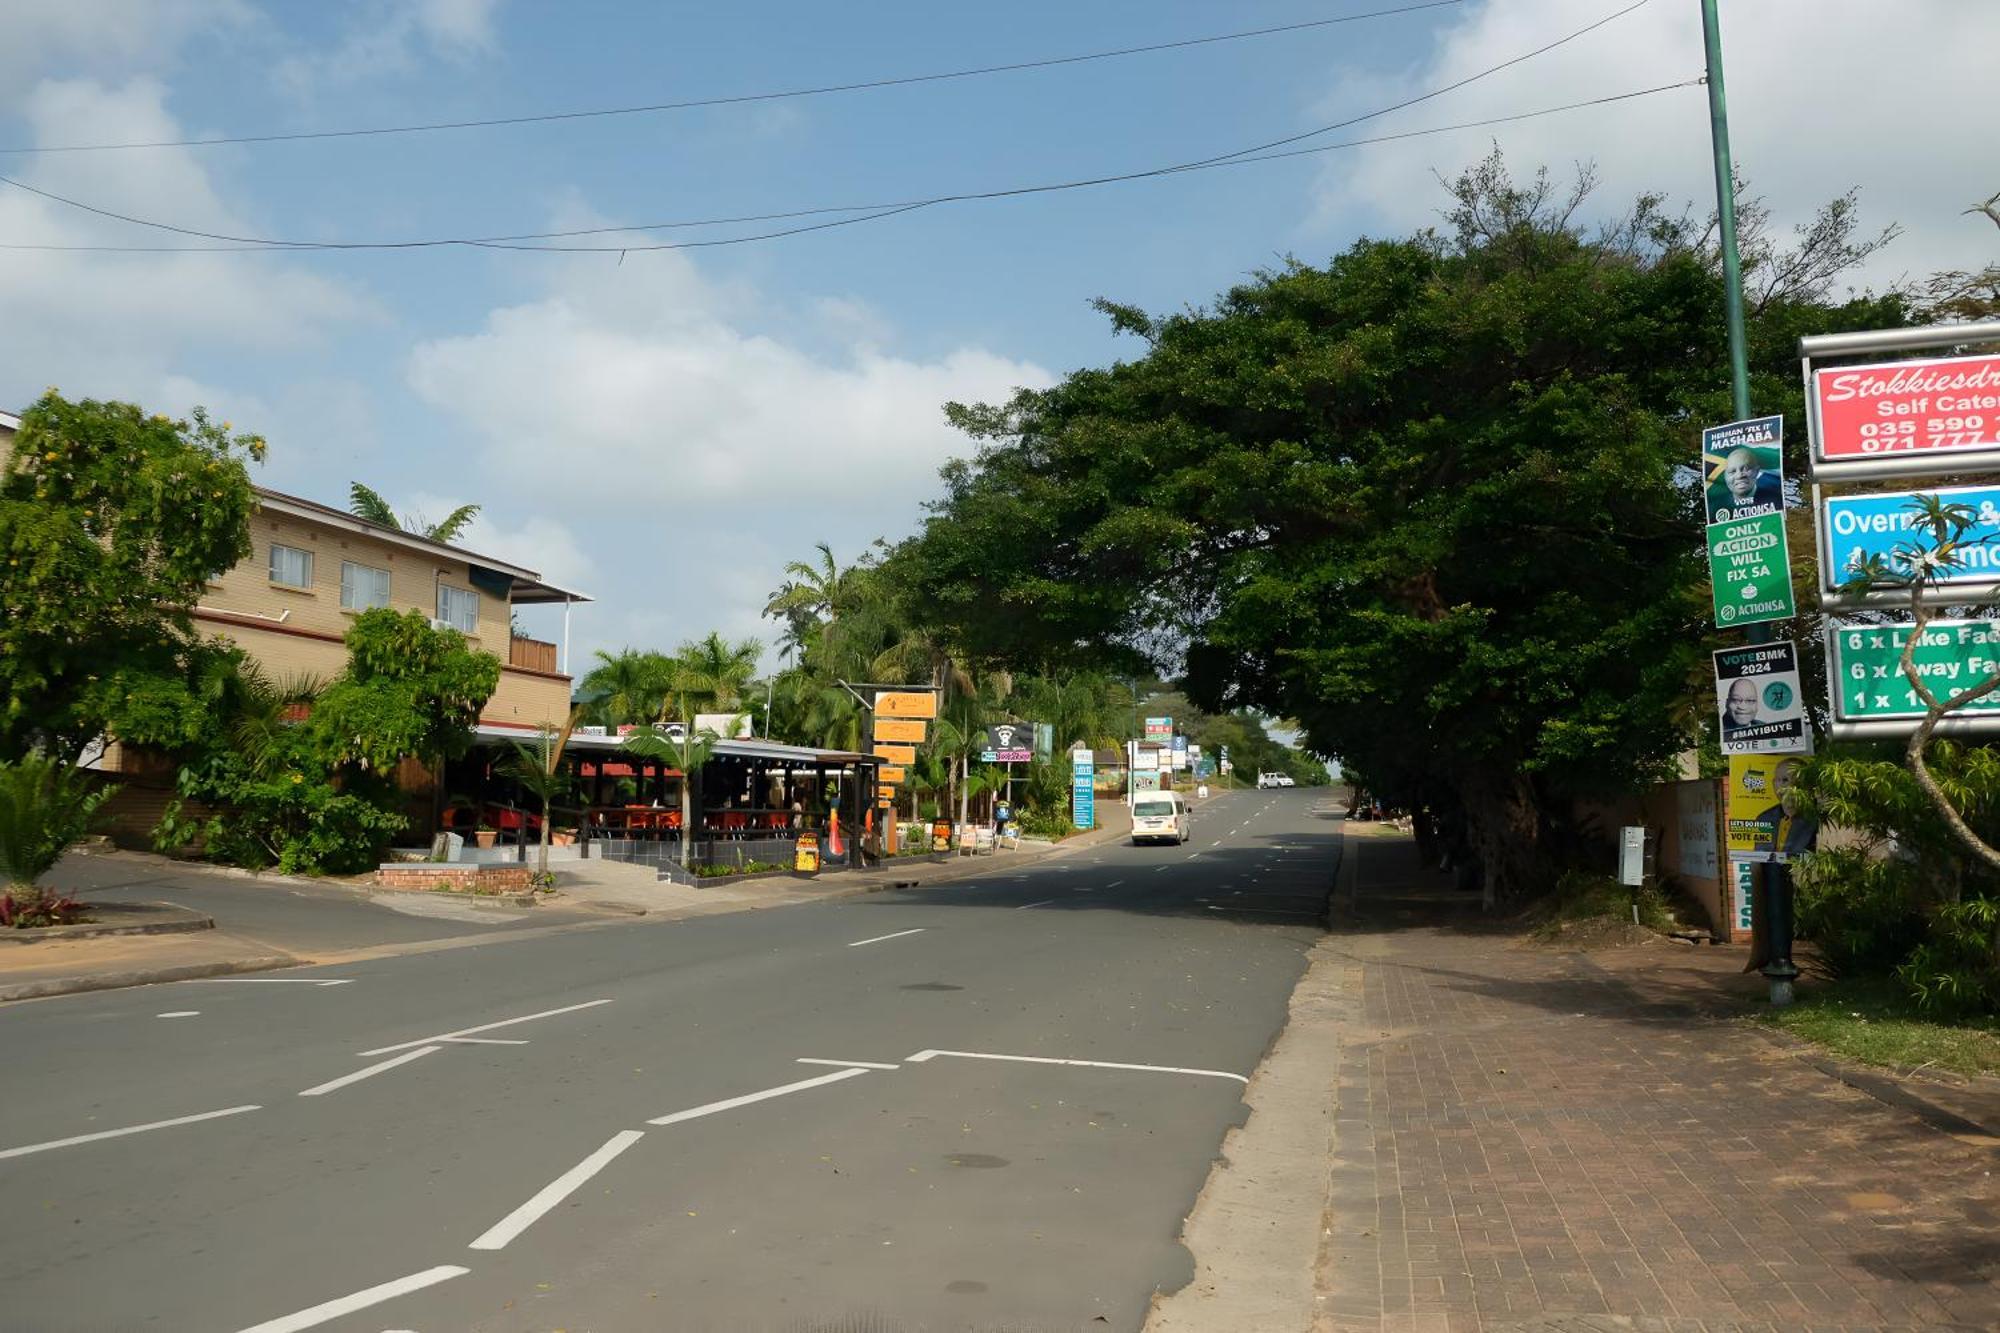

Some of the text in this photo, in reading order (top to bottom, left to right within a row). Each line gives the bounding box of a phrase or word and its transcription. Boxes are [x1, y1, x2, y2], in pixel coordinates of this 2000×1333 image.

[1877, 394, 2000, 417] Self Cate
[1860, 420, 1916, 437] 035
[1927, 415, 1983, 432] 590
[1710, 430, 1773, 450] MASHABA
[1861, 435, 1915, 452] 071
[1927, 431, 1984, 448] 777
[1733, 502, 1777, 519] ACTIONSA
[1834, 501, 2000, 535] Overn &
[1726, 522, 1761, 538] ONLY
[1721, 535, 1771, 554] ACTION
[1731, 552, 1763, 567] WILL
[1727, 565, 1771, 582] FIX SA
[1738, 599, 1786, 616] ACTIONSA
[1848, 633, 1863, 650] 6
[1870, 636, 1885, 649] x
[1892, 630, 1950, 649] Lke
[1722, 649, 1787, 666] VOTE MK
[1741, 662, 1771, 676] 2024
[1851, 663, 1866, 680] 6
[1872, 665, 1888, 678] x
[1968, 656, 2000, 674] Fa
[1854, 691, 1865, 708] 1
[1874, 694, 1890, 708] x
[1732, 722, 1793, 739] #MAYIBUYE
[1727, 740, 1759, 750] VOTE
[1731, 832, 1752, 841] VOTE
